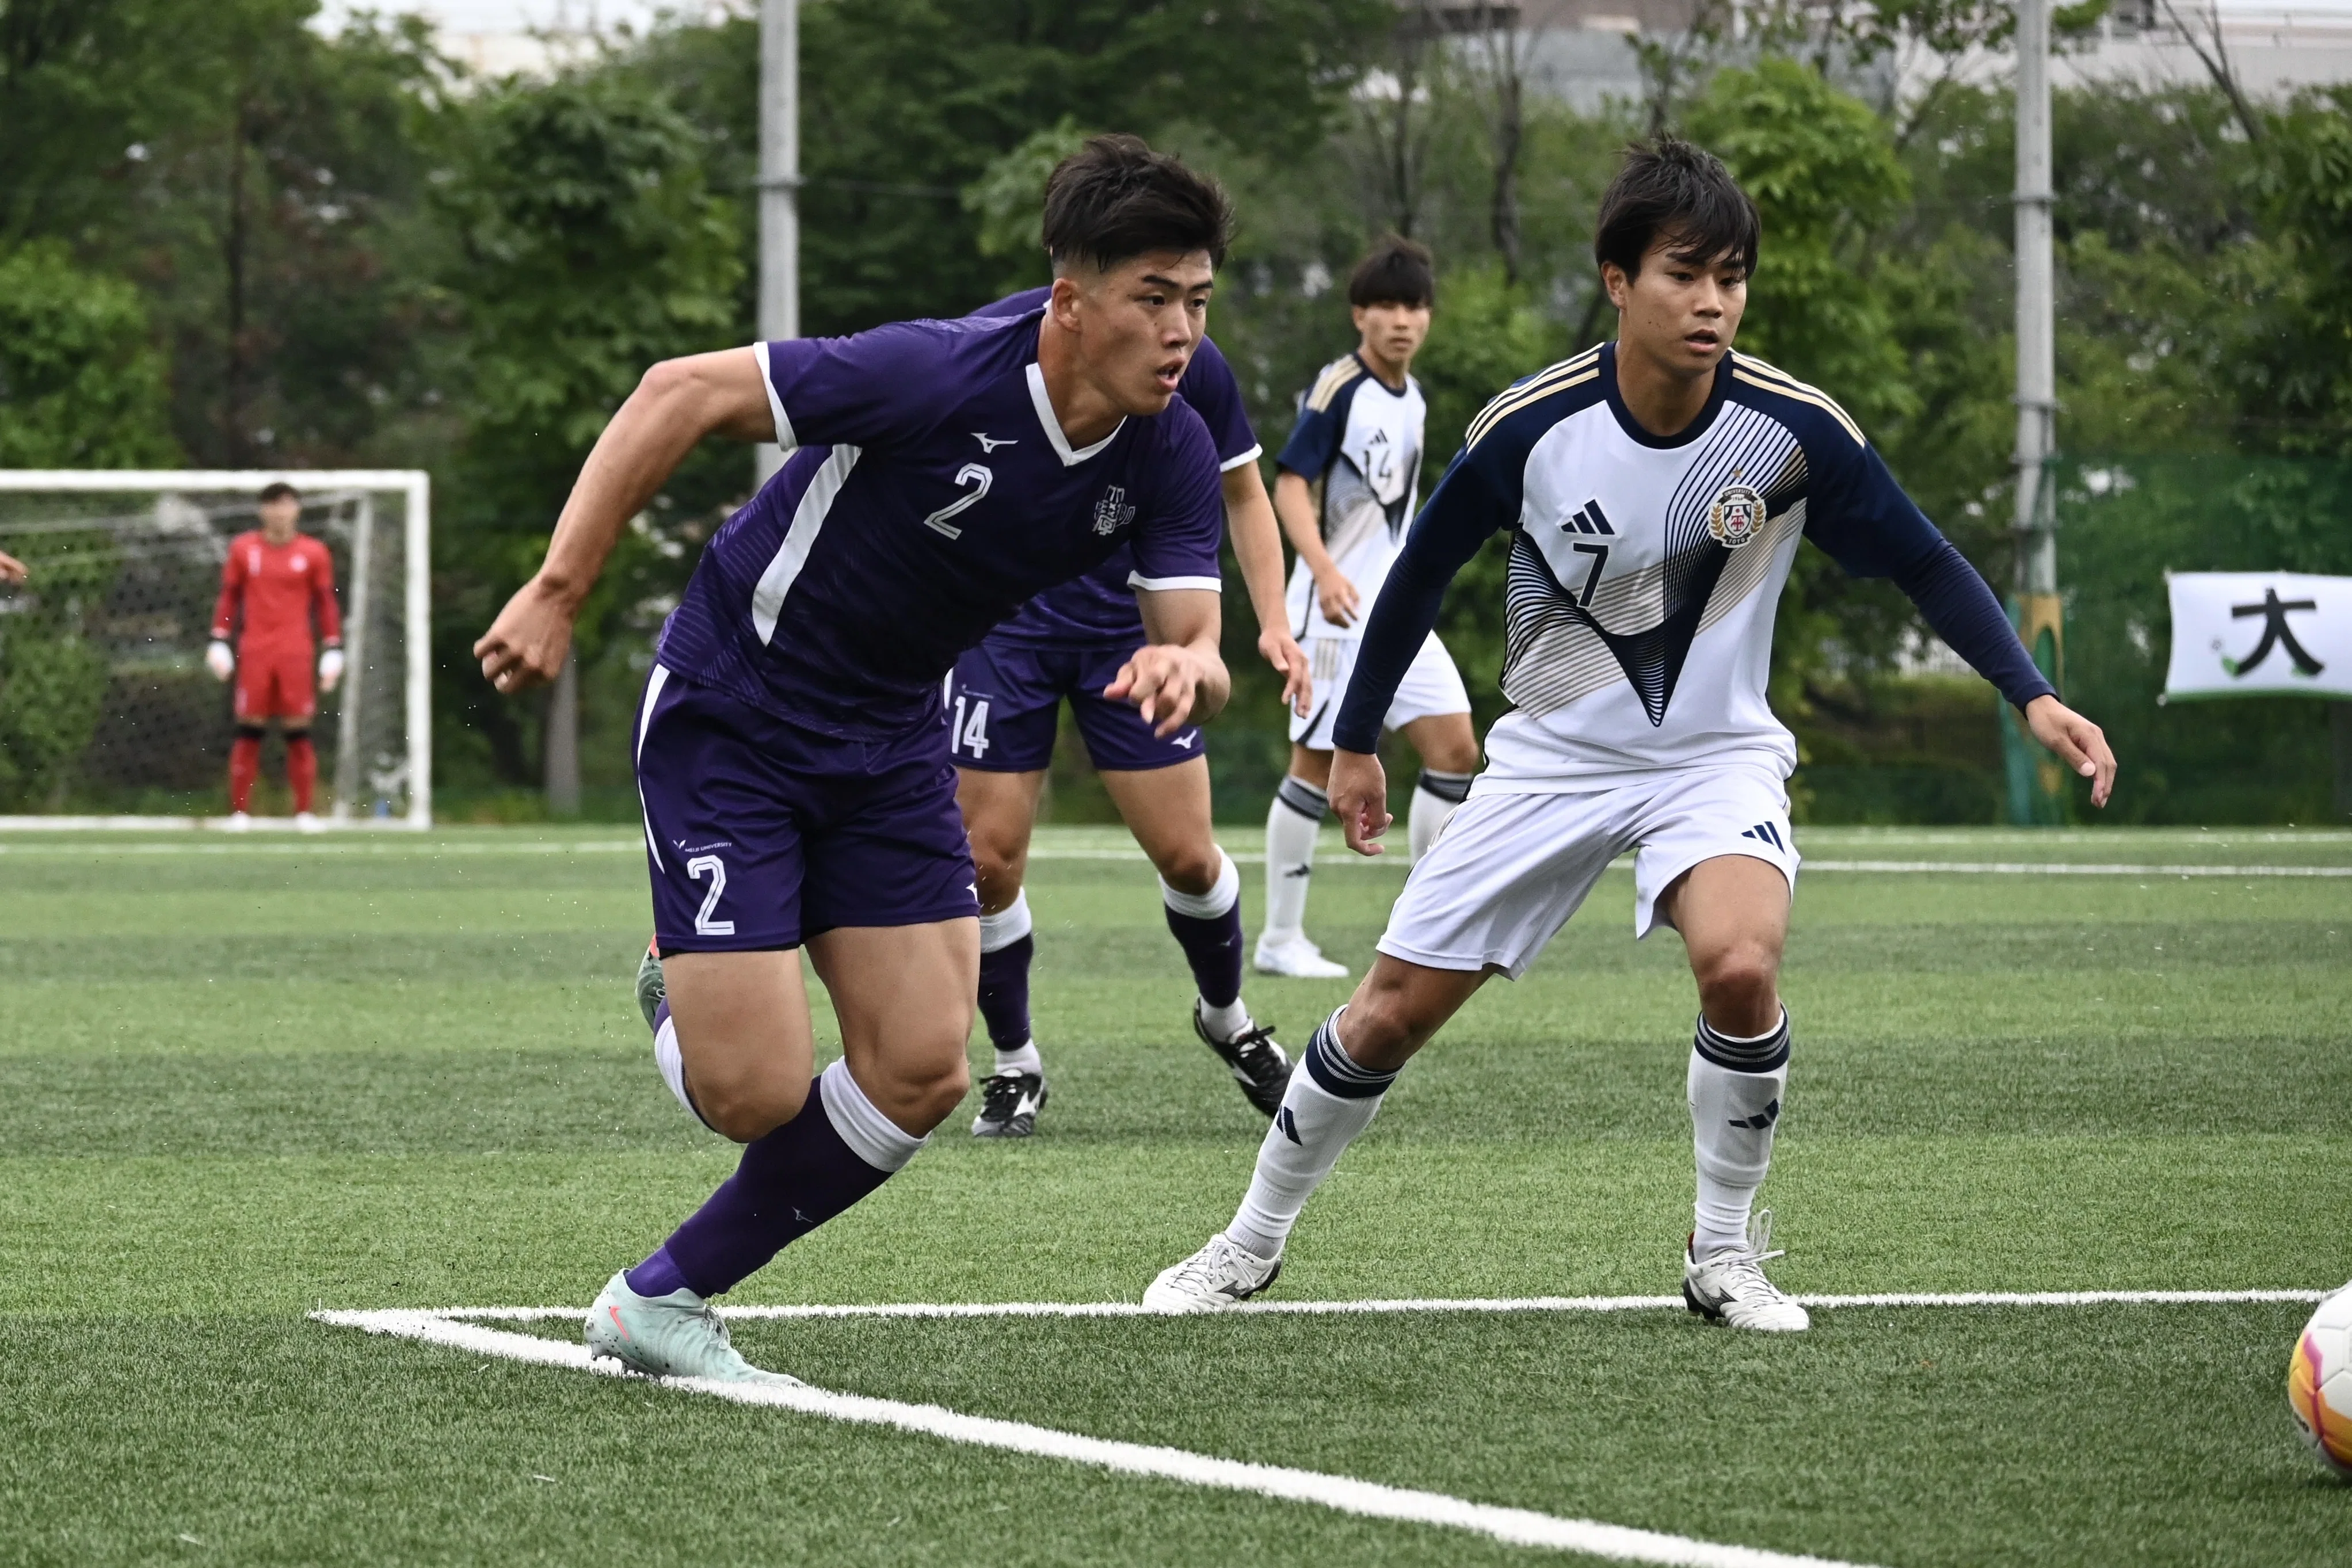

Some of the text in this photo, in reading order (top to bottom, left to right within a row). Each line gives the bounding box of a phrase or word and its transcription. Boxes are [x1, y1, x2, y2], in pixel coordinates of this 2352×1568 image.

[924, 463, 993, 540] 2
[1573, 542, 1608, 608] 7
[2231, 587, 2325, 677] 大
[951, 695, 990, 759] 14
[700, 842, 733, 852] UNIVERSITY
[687, 854, 735, 936] 2
